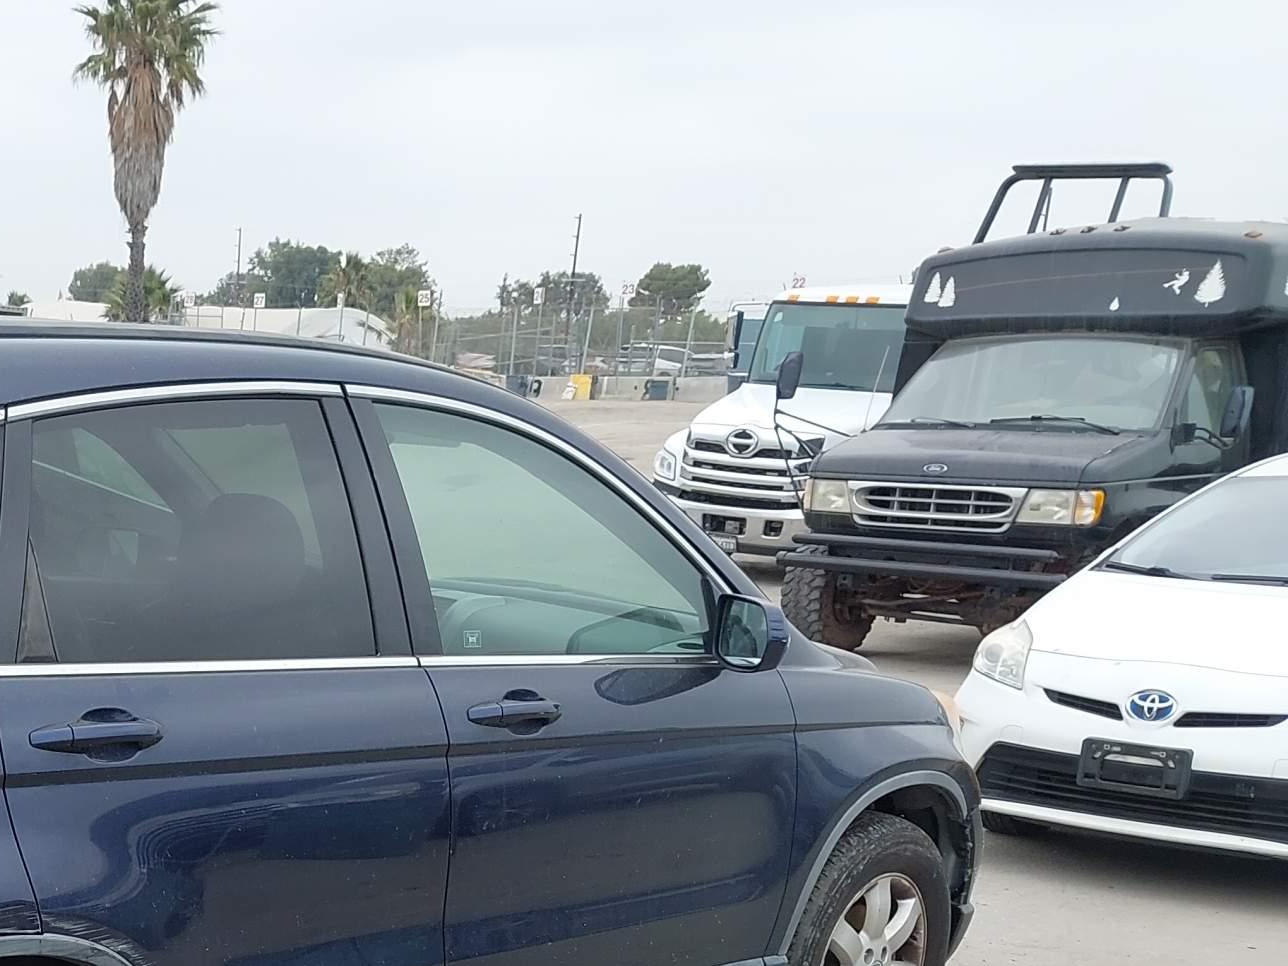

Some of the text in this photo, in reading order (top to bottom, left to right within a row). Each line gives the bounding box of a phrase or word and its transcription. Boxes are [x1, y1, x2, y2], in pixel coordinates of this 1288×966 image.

[792, 277, 806, 288] 22
[622, 285, 634, 294] 23
[255, 295, 265, 306] 27
[419, 293, 430, 303] 25
